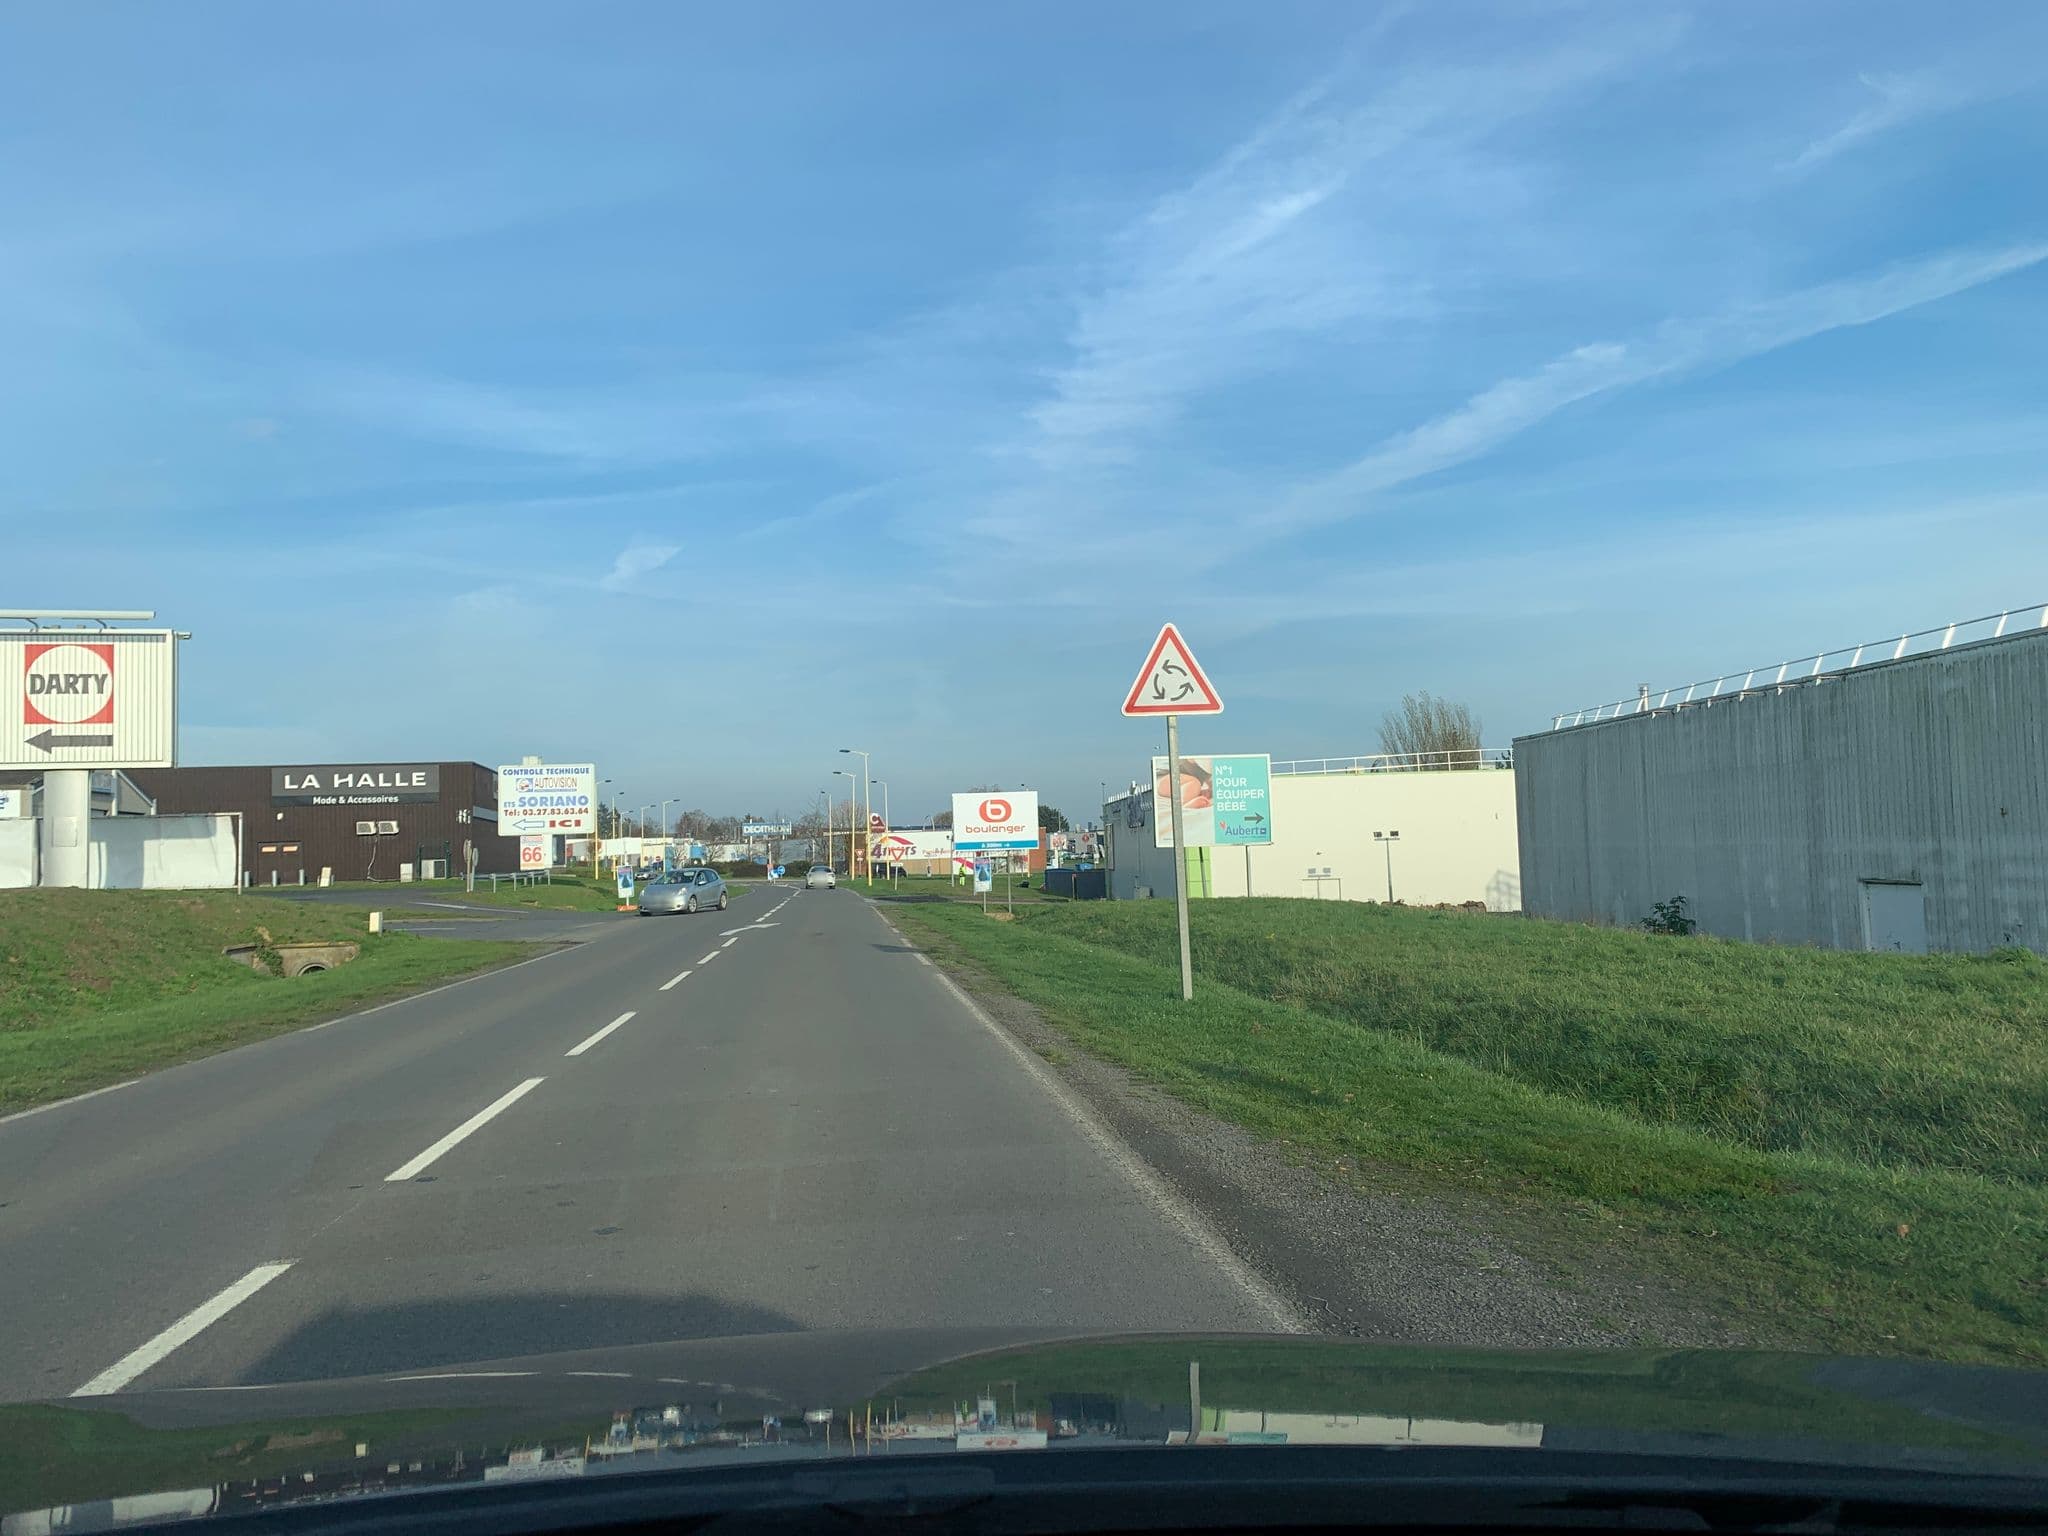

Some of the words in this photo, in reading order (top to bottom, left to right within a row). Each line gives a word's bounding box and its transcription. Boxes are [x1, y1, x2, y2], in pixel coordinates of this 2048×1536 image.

[29, 674, 108, 695] DARTY
[503, 768, 544, 776] CONTROLE
[546, 767, 590, 775] TECHNIQUE
[1215, 765, 1232, 776] N°1
[284, 774, 320, 789] LA
[333, 772, 426, 788] HALLE
[534, 777, 578, 788] AUTOVISION
[1216, 777, 1247, 788] POUR
[1216, 788, 1265, 800] ÉQUIPER
[313, 796, 337, 805] Mode
[338, 796, 346, 805] &
[347, 795, 399, 805] Accessoires
[518, 795, 589, 807] SORIANO
[1216, 800, 1248, 811] BÉBÉ
[549, 819, 581, 828] ICI
[965, 825, 1026, 834] boulanger
[1225, 826, 1259, 836] Aubert
[522, 847, 542, 862] 66
